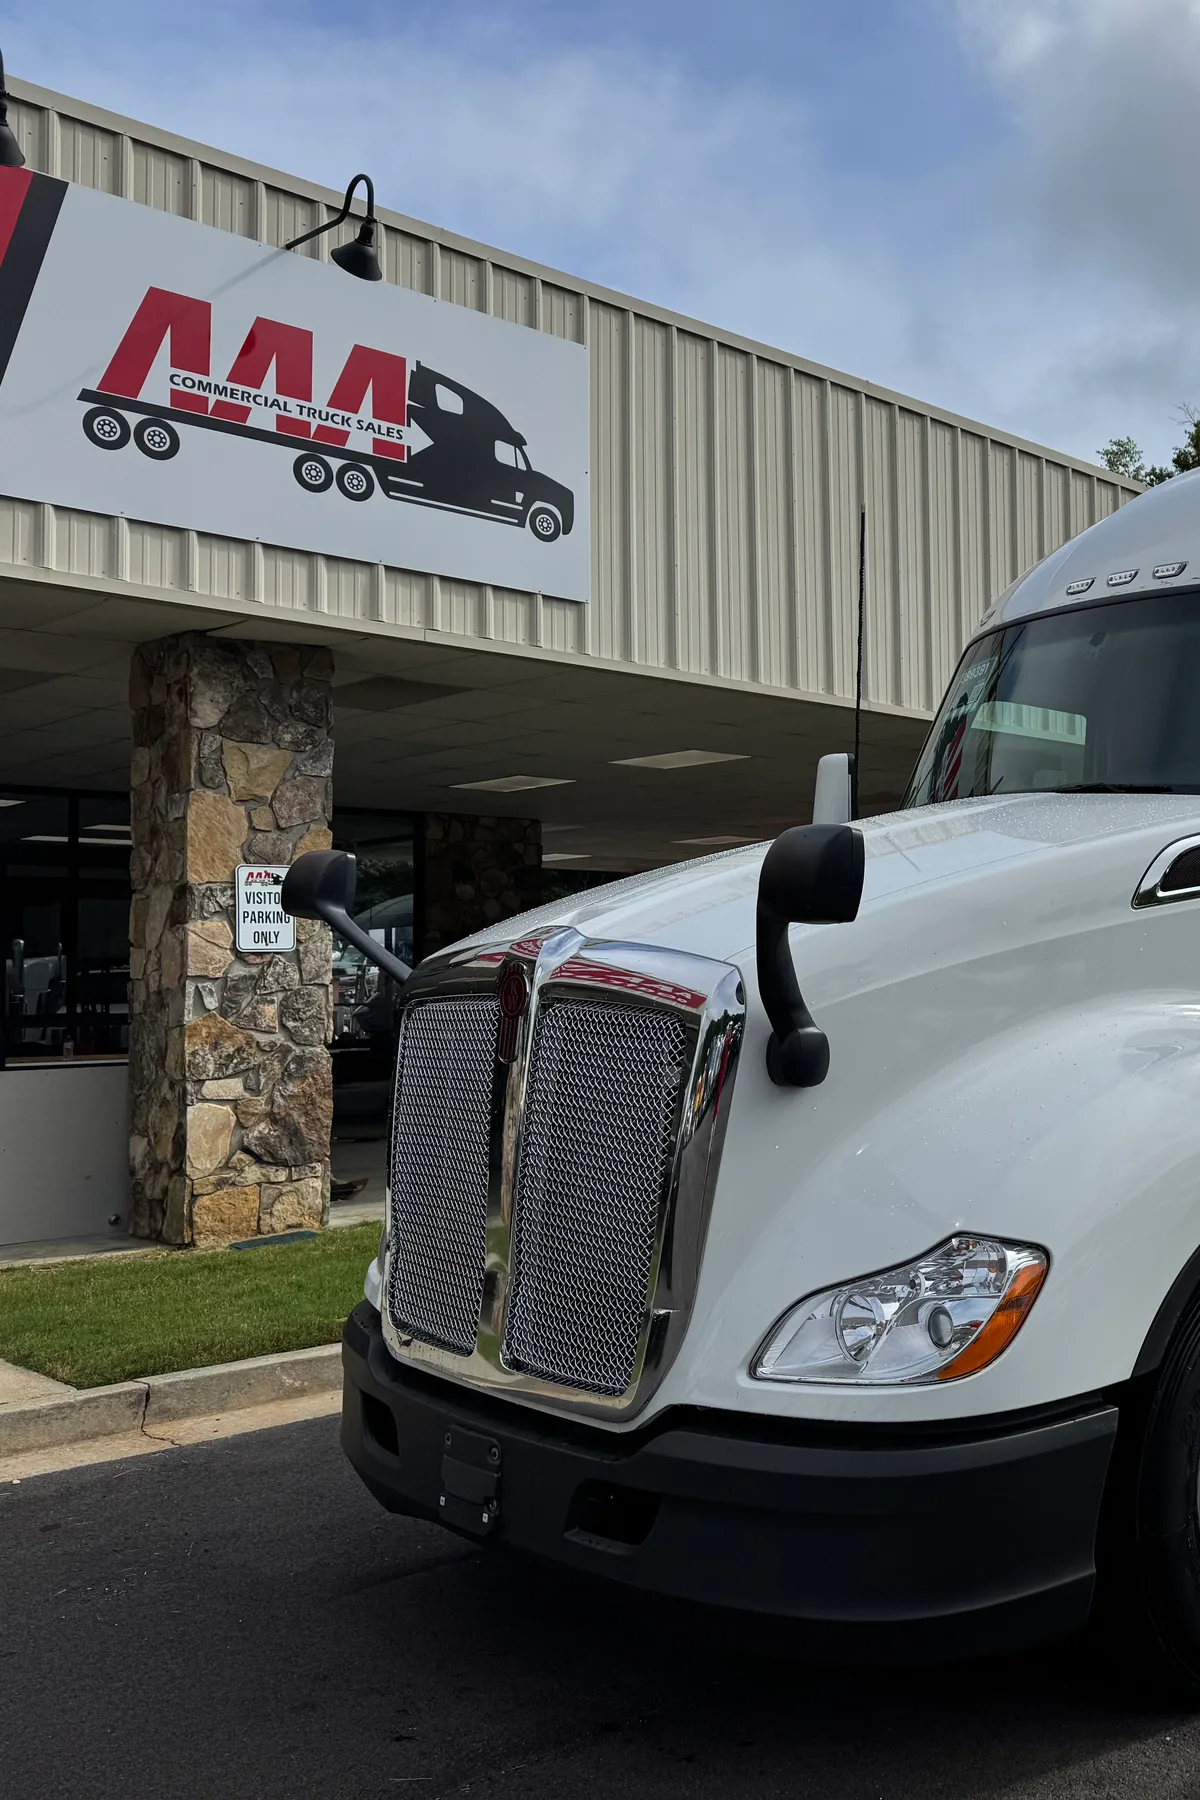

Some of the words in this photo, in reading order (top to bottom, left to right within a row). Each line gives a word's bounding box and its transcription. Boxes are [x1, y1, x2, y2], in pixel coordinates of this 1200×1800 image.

[96, 286, 406, 461] AAA
[169, 373, 292, 414] COMMERCIAL
[296, 403, 352, 428] TRUCK
[356, 419, 404, 440] SALES
[245, 891, 281, 905] VISITO
[242, 911, 290, 924] PARKING
[253, 931, 280, 944] ONLY
